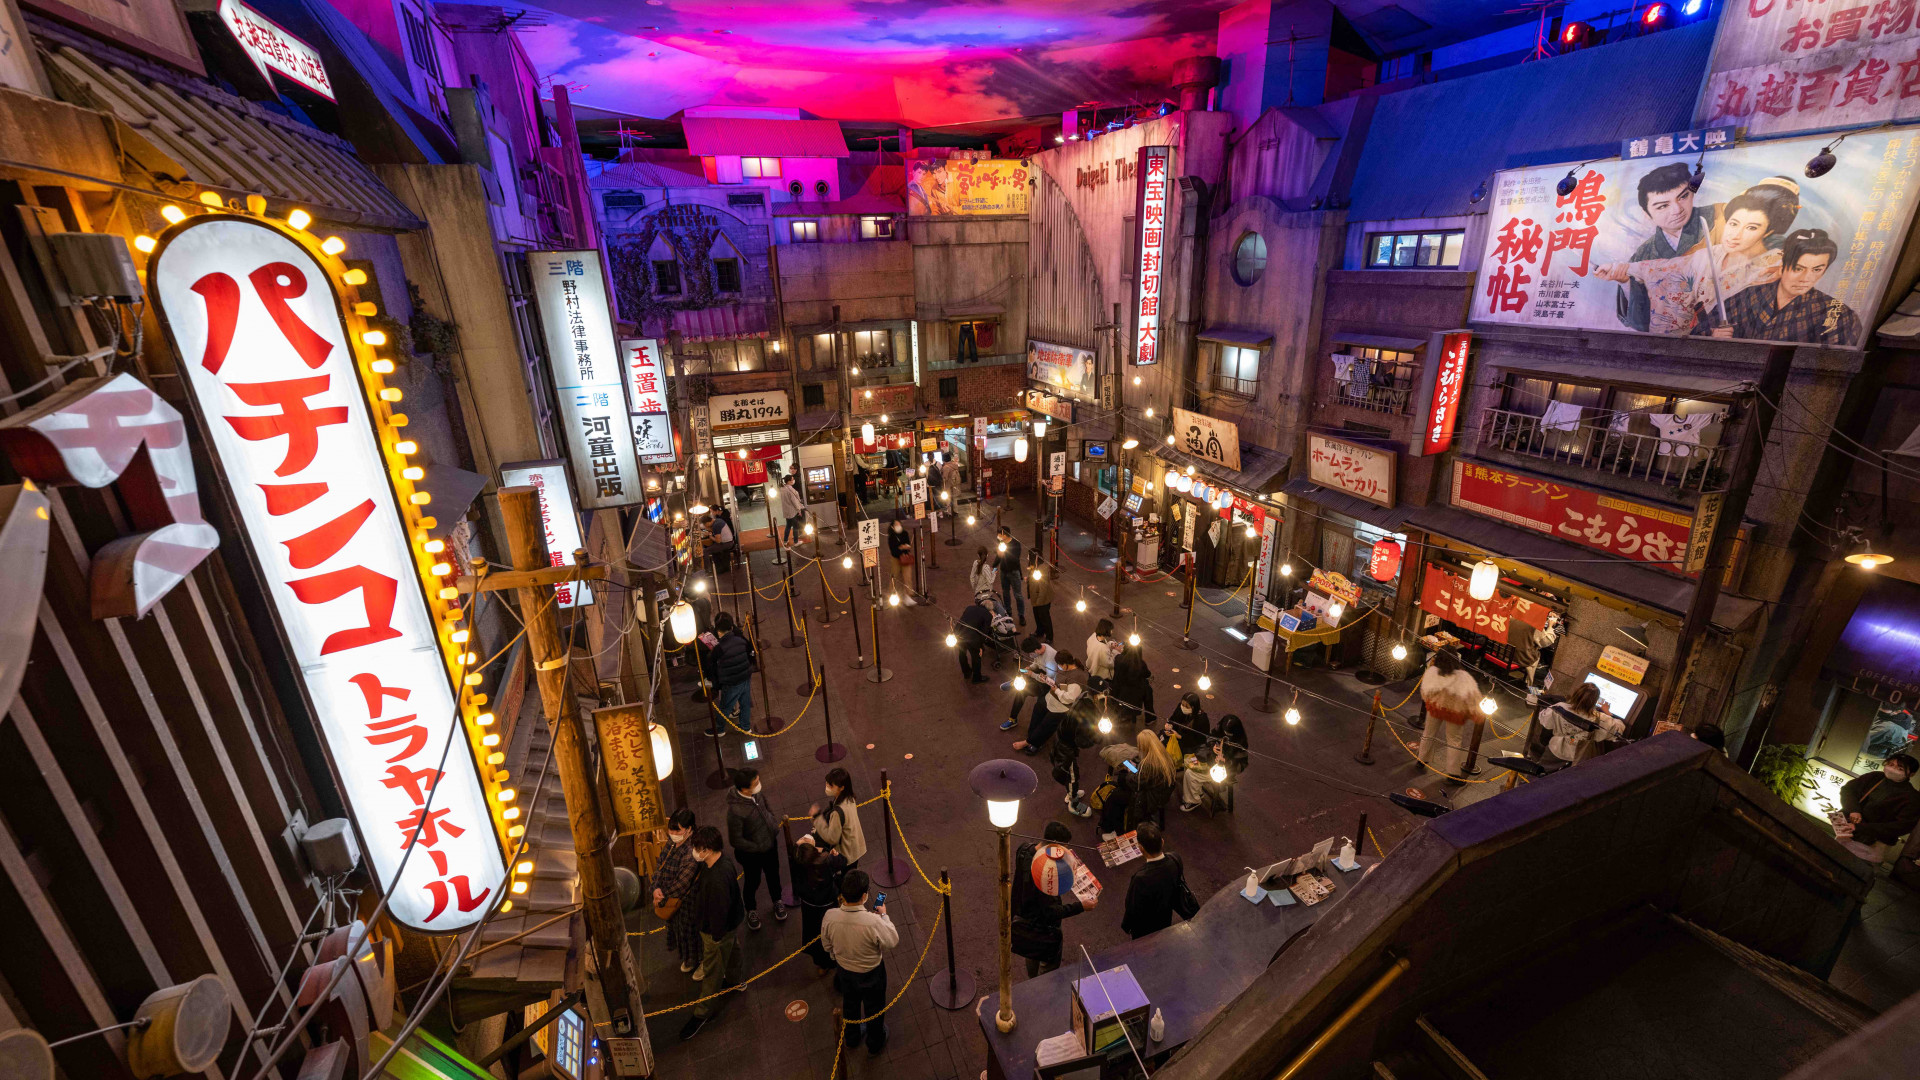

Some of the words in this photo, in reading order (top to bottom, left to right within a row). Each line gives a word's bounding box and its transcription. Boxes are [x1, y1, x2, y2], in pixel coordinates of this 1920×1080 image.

[1628, 130, 1728, 158] 鶴亀大映
[1076, 160, 1109, 192] Daigeki
[1540, 169, 1607, 278] 鳴門
[548, 259, 585, 277] 三階
[1486, 217, 1544, 315] 秘帖
[562, 279, 594, 381] 野村法律事務所
[1037, 348, 1074, 368] 地球防衛軍
[576, 392, 609, 408] 二階
[1431, 350, 1456, 443] こむらさき
[695, 406, 710, 448] 川添硝子
[189, 261, 404, 656] パチンコ
[581, 415, 624, 499] 河童出版
[1312, 447, 1364, 473] ホームラン
[1332, 471, 1388, 498] ベーカリー
[1473, 466, 1569, 501] 熊本ラーメン
[1257, 534, 1270, 589] オリオンビール
[622, 714, 645, 759] 安心して
[347, 672, 491, 924] トラヤホール
